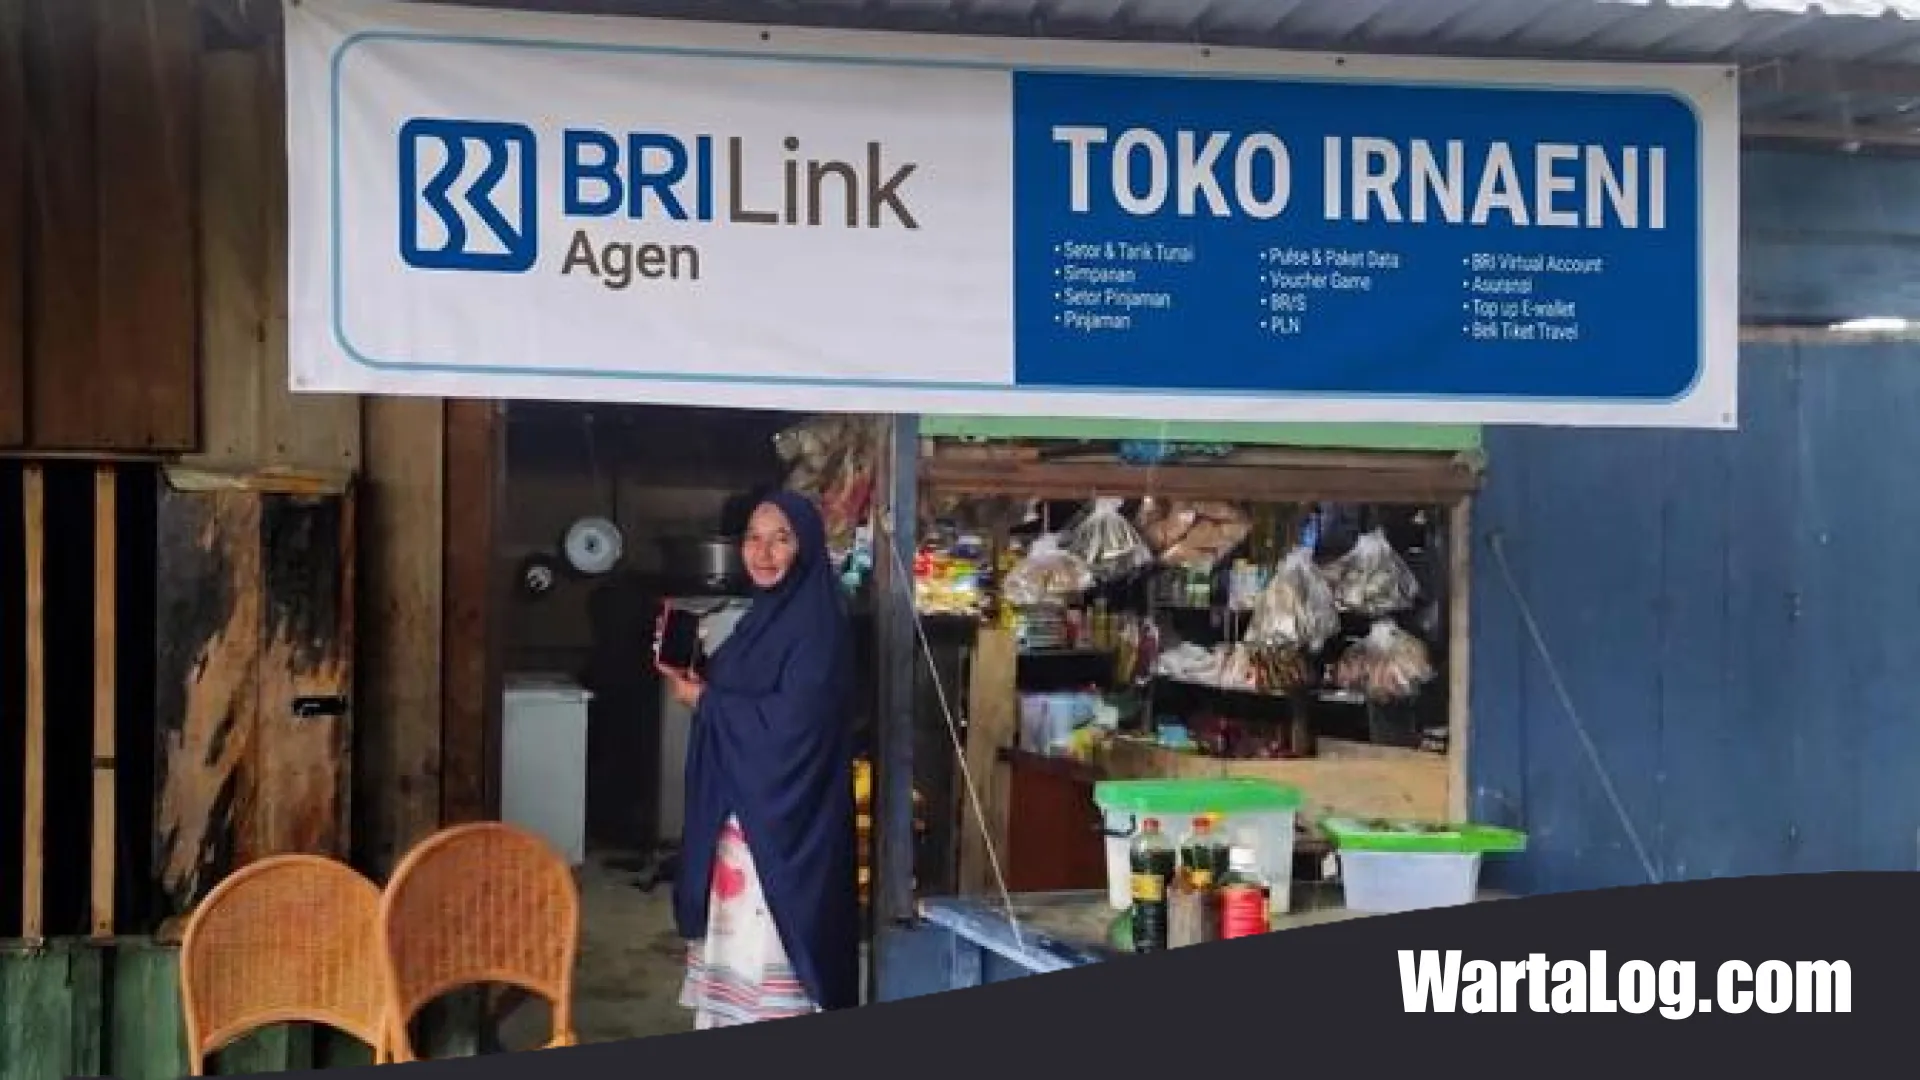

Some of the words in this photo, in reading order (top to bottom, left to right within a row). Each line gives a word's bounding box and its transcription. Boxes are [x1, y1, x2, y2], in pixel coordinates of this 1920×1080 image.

[1052, 125, 1291, 220] TOKO
[1324, 136, 1667, 229] IRNAENI
[561, 229, 699, 289] Agen
[1104, 242, 1115, 260] &
[1367, 250, 1399, 269] Data
[1497, 253, 1544, 271] Virtual
[1546, 255, 1603, 274] Account
[1269, 269, 1327, 289] Voucher
[1330, 270, 1371, 291] Game
[1474, 299, 1498, 319] Top
[1500, 301, 1519, 319] up
[1522, 299, 1576, 317] E-wallet
[1271, 316, 1301, 334] PLN
[1537, 322, 1579, 341] Travel
